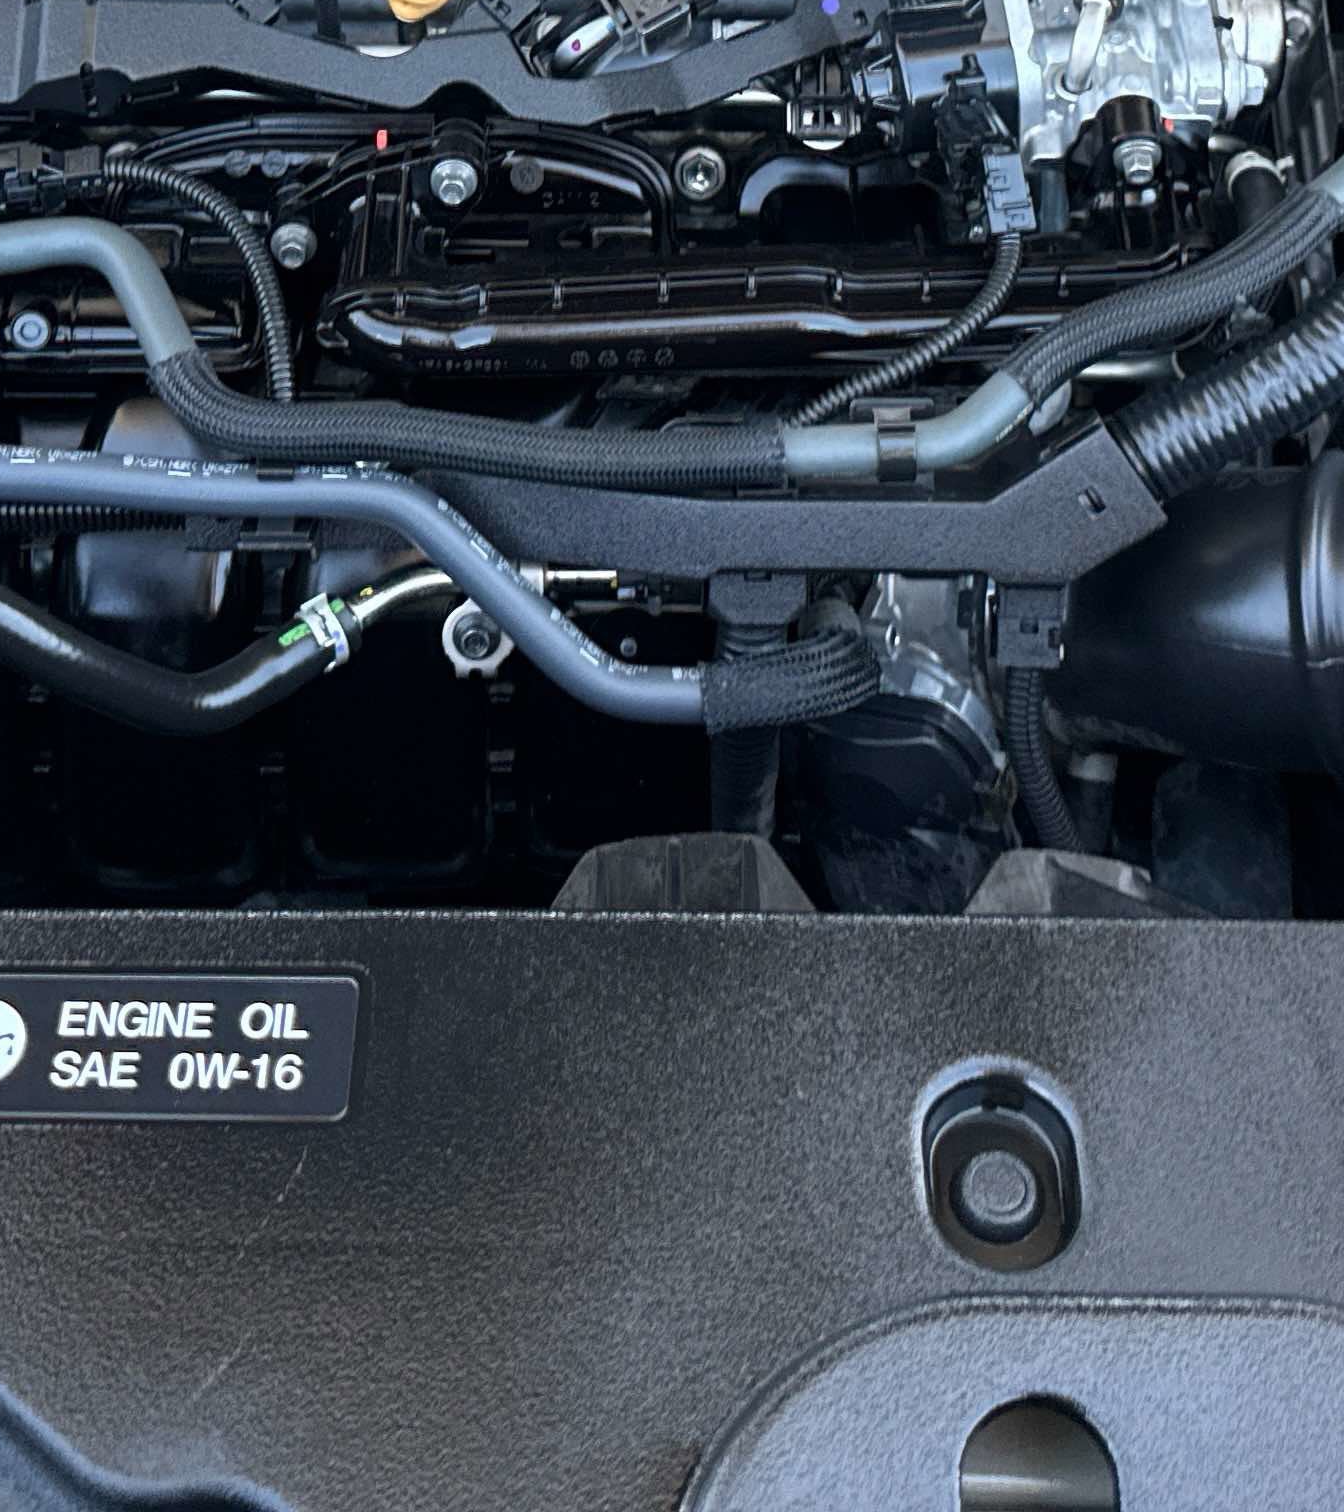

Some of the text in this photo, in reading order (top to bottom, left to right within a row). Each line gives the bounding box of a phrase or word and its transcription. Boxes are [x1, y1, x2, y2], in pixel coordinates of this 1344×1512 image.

[58, 1000, 309, 1039] ENGINE OIL
[49, 1050, 304, 1091] SAE 0W-16
